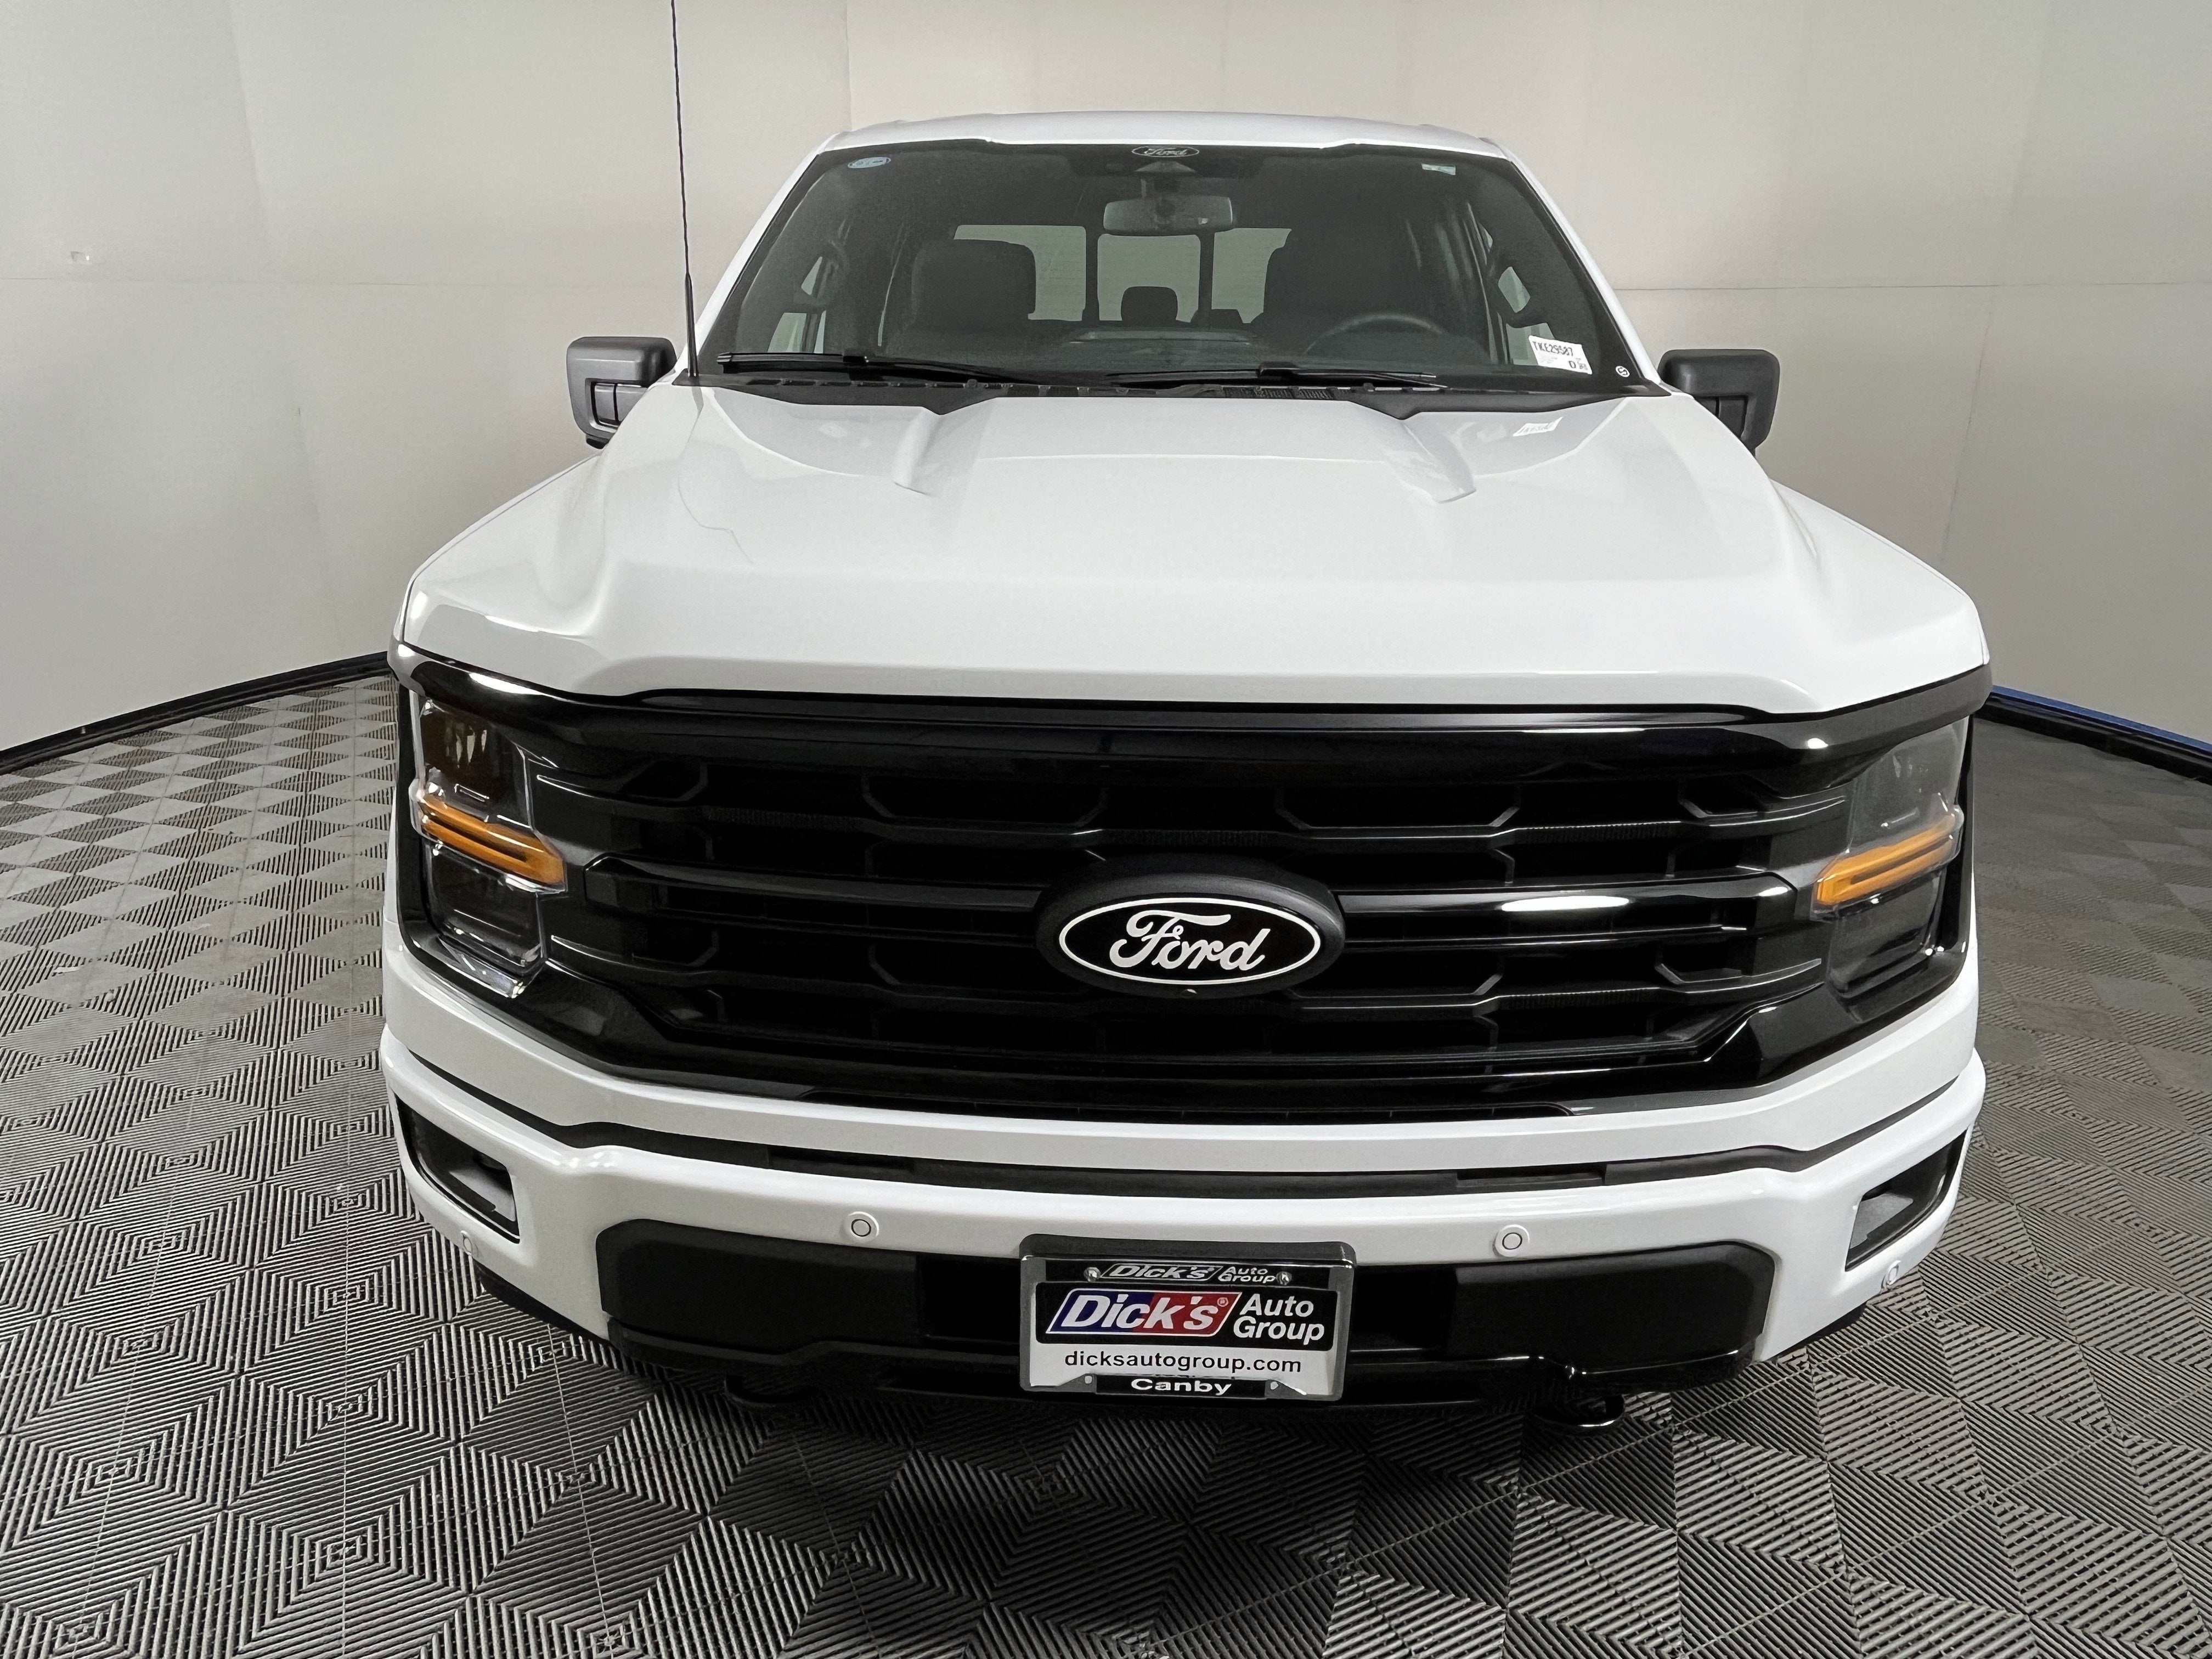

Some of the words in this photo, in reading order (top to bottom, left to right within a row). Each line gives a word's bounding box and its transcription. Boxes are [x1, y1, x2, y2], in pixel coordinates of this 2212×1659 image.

[1144, 147, 1188, 155] Ford
[1109, 910, 1271, 970] Ford
[1109, 1265, 1210, 1279] Dick's
[1222, 1266, 1268, 1275] Auto
[1218, 1274, 1277, 1284] Group
[1239, 1294, 1314, 1317] Auto
[1233, 1317, 1325, 1345] Group
[1065, 1351, 1301, 1374] dicksautogroup.com
[1131, 1379, 1232, 1395] Canby
